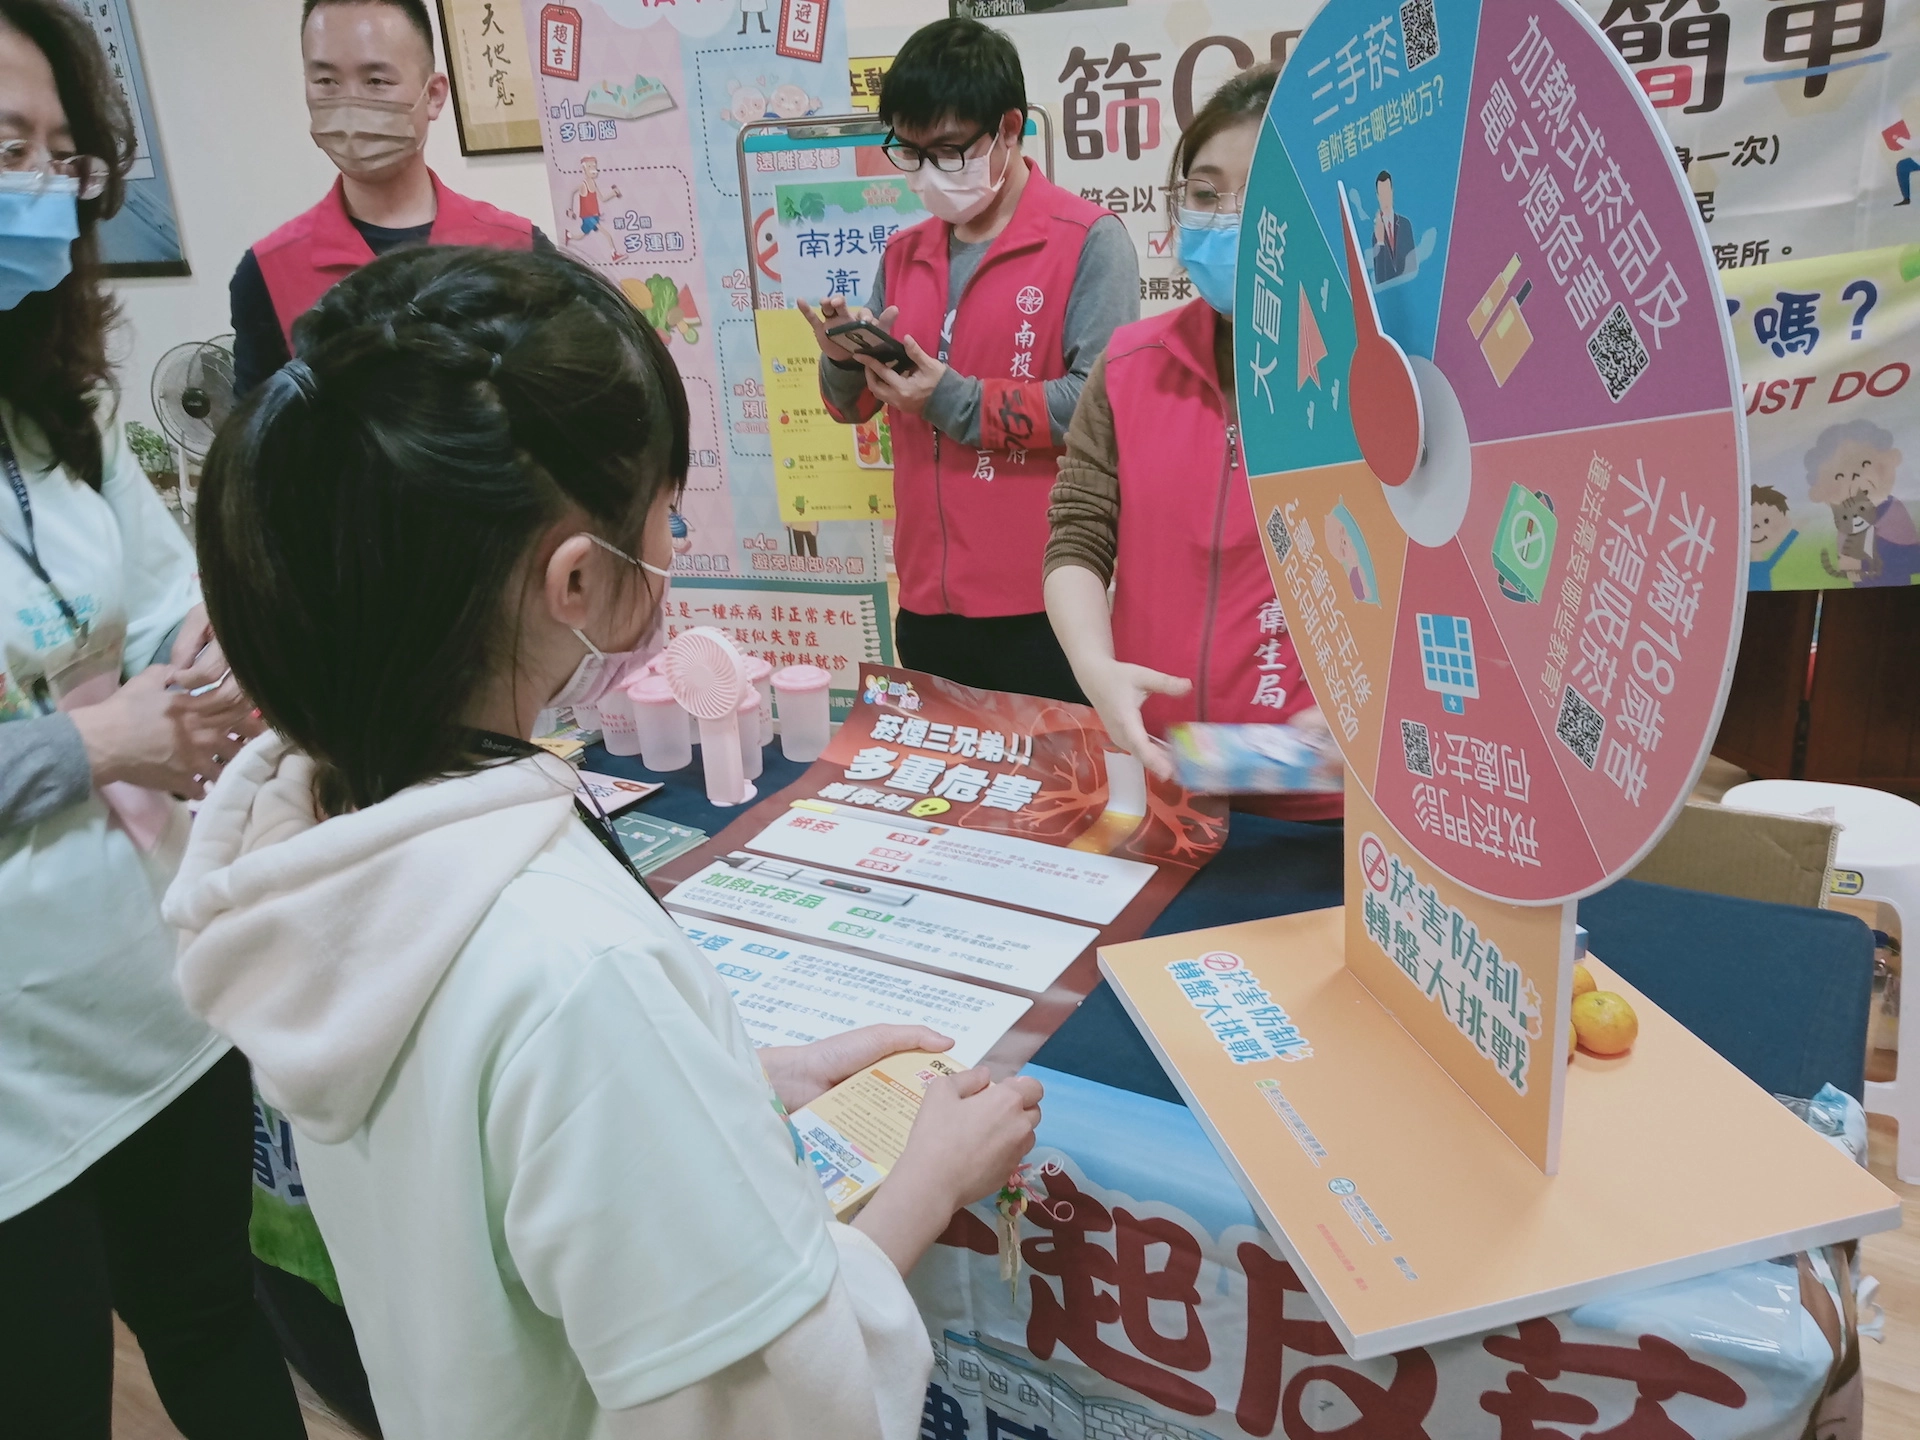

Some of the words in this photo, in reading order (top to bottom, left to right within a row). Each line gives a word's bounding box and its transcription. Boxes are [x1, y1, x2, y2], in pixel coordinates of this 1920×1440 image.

[1307, 15, 1400, 125] 三手菸
[560, 120, 617, 142] 多動腦
[756, 148, 841, 172] 遠離憂鬱
[1507, 14, 1688, 350] 加熱式菸品及
[624, 232, 684, 253] 多運動
[1479, 77, 1611, 331] 電子煙危害
[1250, 206, 1288, 414] 大冒險
[1828, 362, 1911, 404] DO
[752, 553, 864, 574] 避免頭部外傷
[1572, 458, 1667, 708] 不得吸菸
[1603, 491, 1716, 807] 未滿18歲者
[844, 745, 1042, 812] 多重危害
[1412, 782, 1541, 867] 戒菸門診
[1365, 891, 1526, 1089] 轉盤大挑戰
[1389, 859, 1522, 1020] 菸害防制
[1168, 961, 1270, 1063] 轉盤大挑戰
[1215, 969, 1305, 1050] 菸害防制
